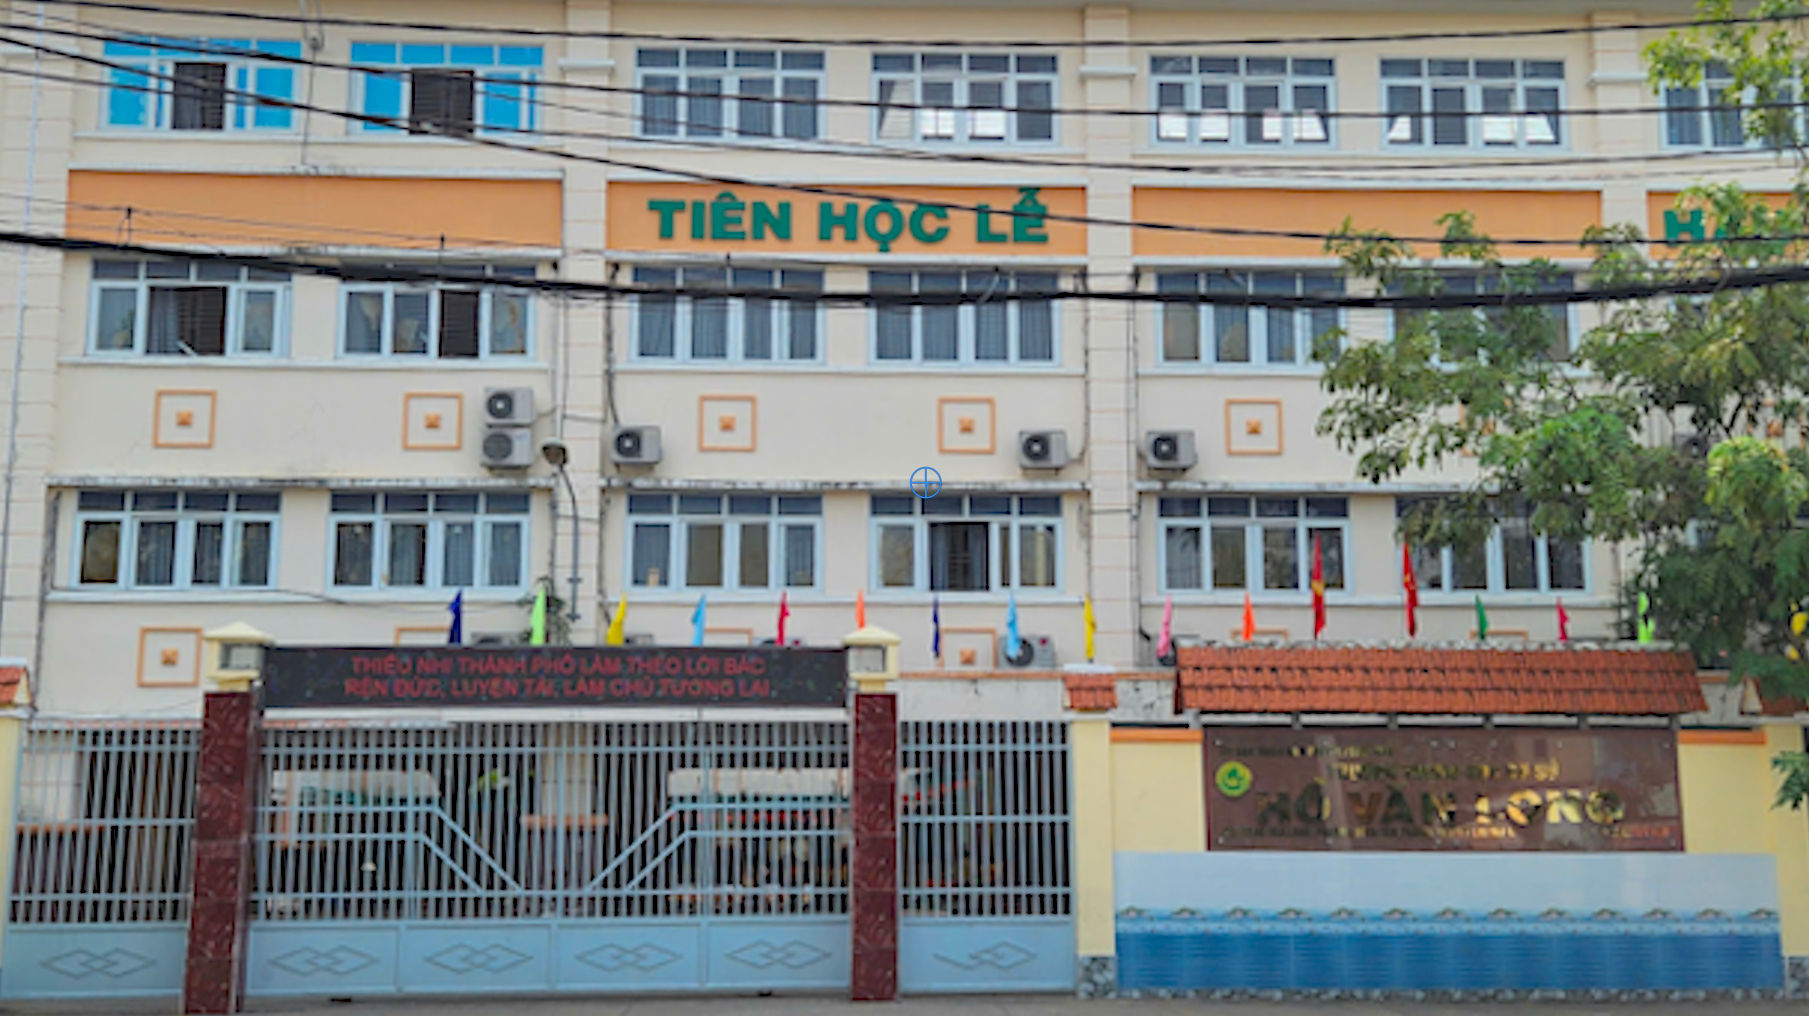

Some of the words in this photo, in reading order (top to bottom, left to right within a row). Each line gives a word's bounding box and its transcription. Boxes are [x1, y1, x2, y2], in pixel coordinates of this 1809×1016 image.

[648, 191, 791, 241] TIÊN
[818, 199, 951, 253] HỌC
[976, 187, 1049, 244] LỄ
[416, 656, 453, 675] NHI
[626, 655, 682, 676] THEO
